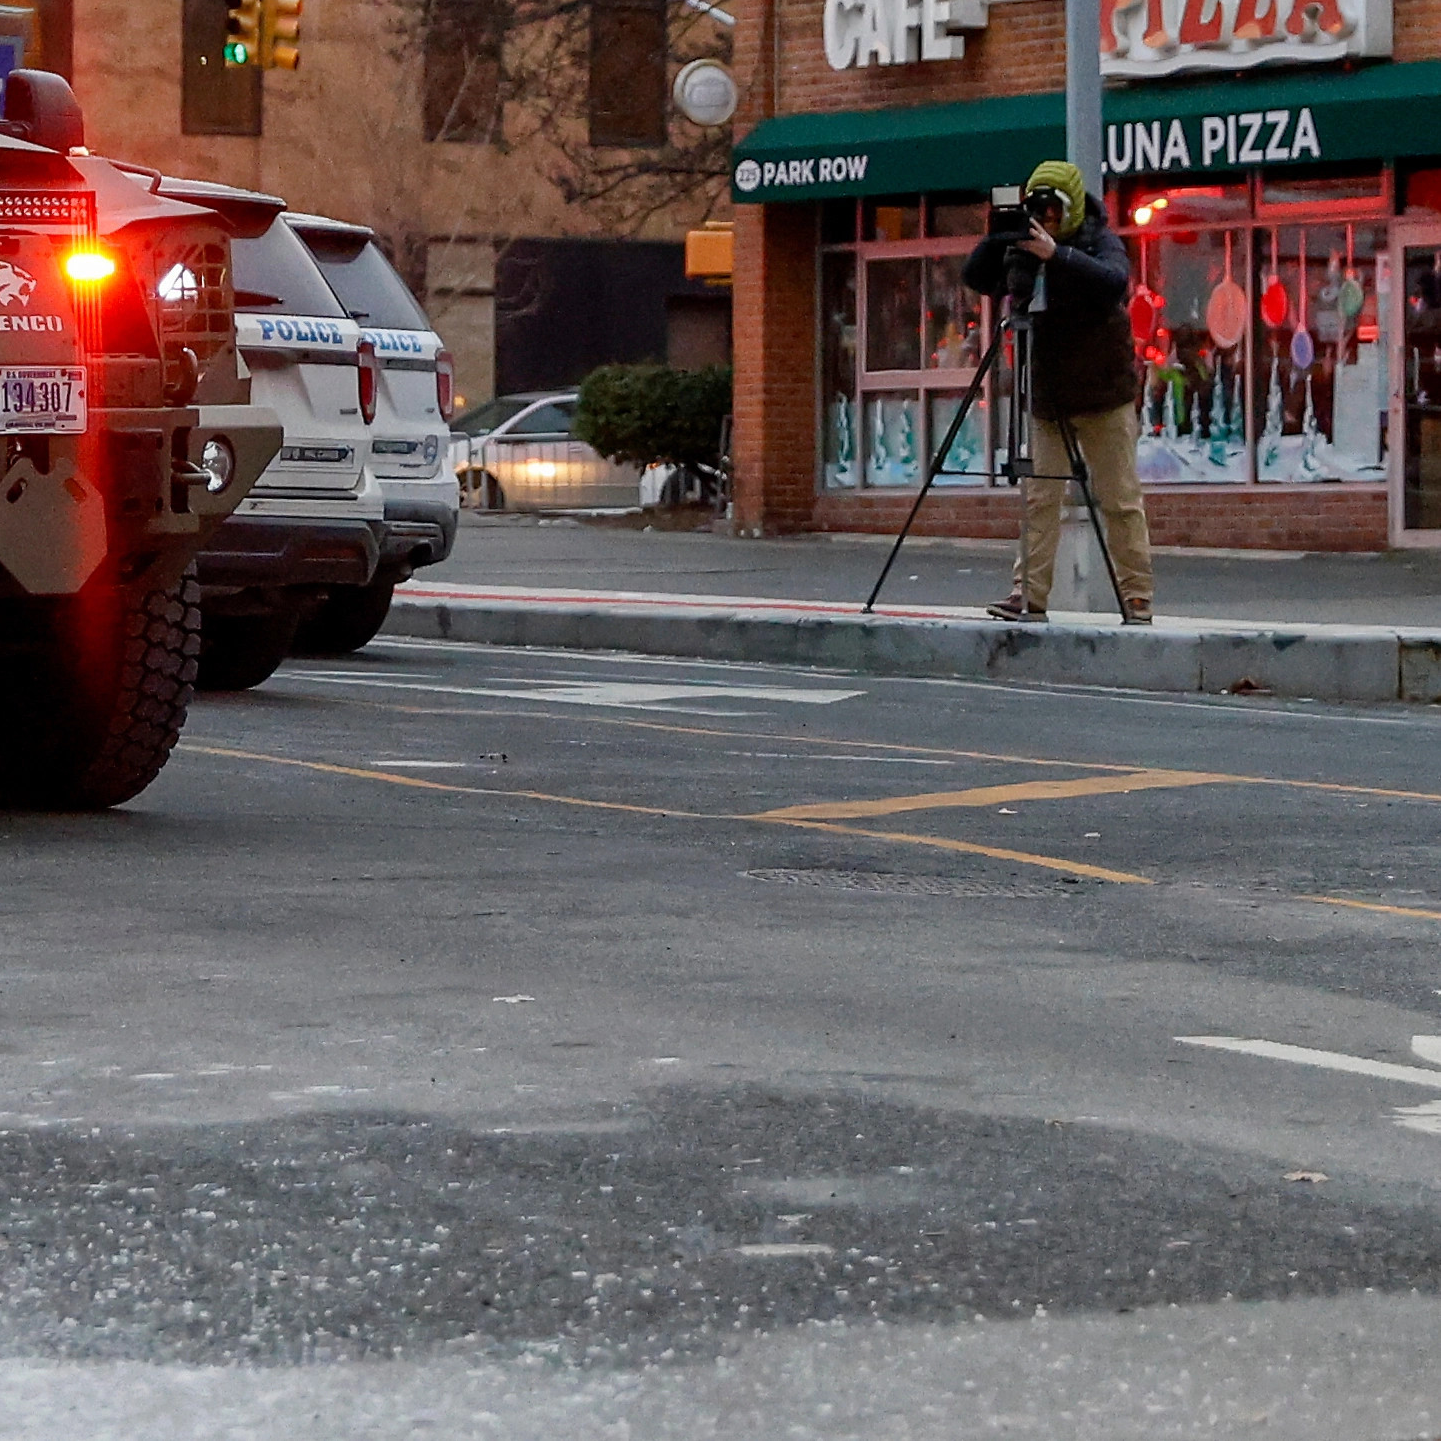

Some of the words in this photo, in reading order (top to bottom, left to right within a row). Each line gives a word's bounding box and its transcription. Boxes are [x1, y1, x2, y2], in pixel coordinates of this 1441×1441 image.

[1202, 107, 1322, 166] PIZZA
[763, 159, 815, 187] PARK
[819, 155, 868, 183] ROW
[256, 318, 344, 345] POLICE
[361, 332, 423, 353] OLICE
